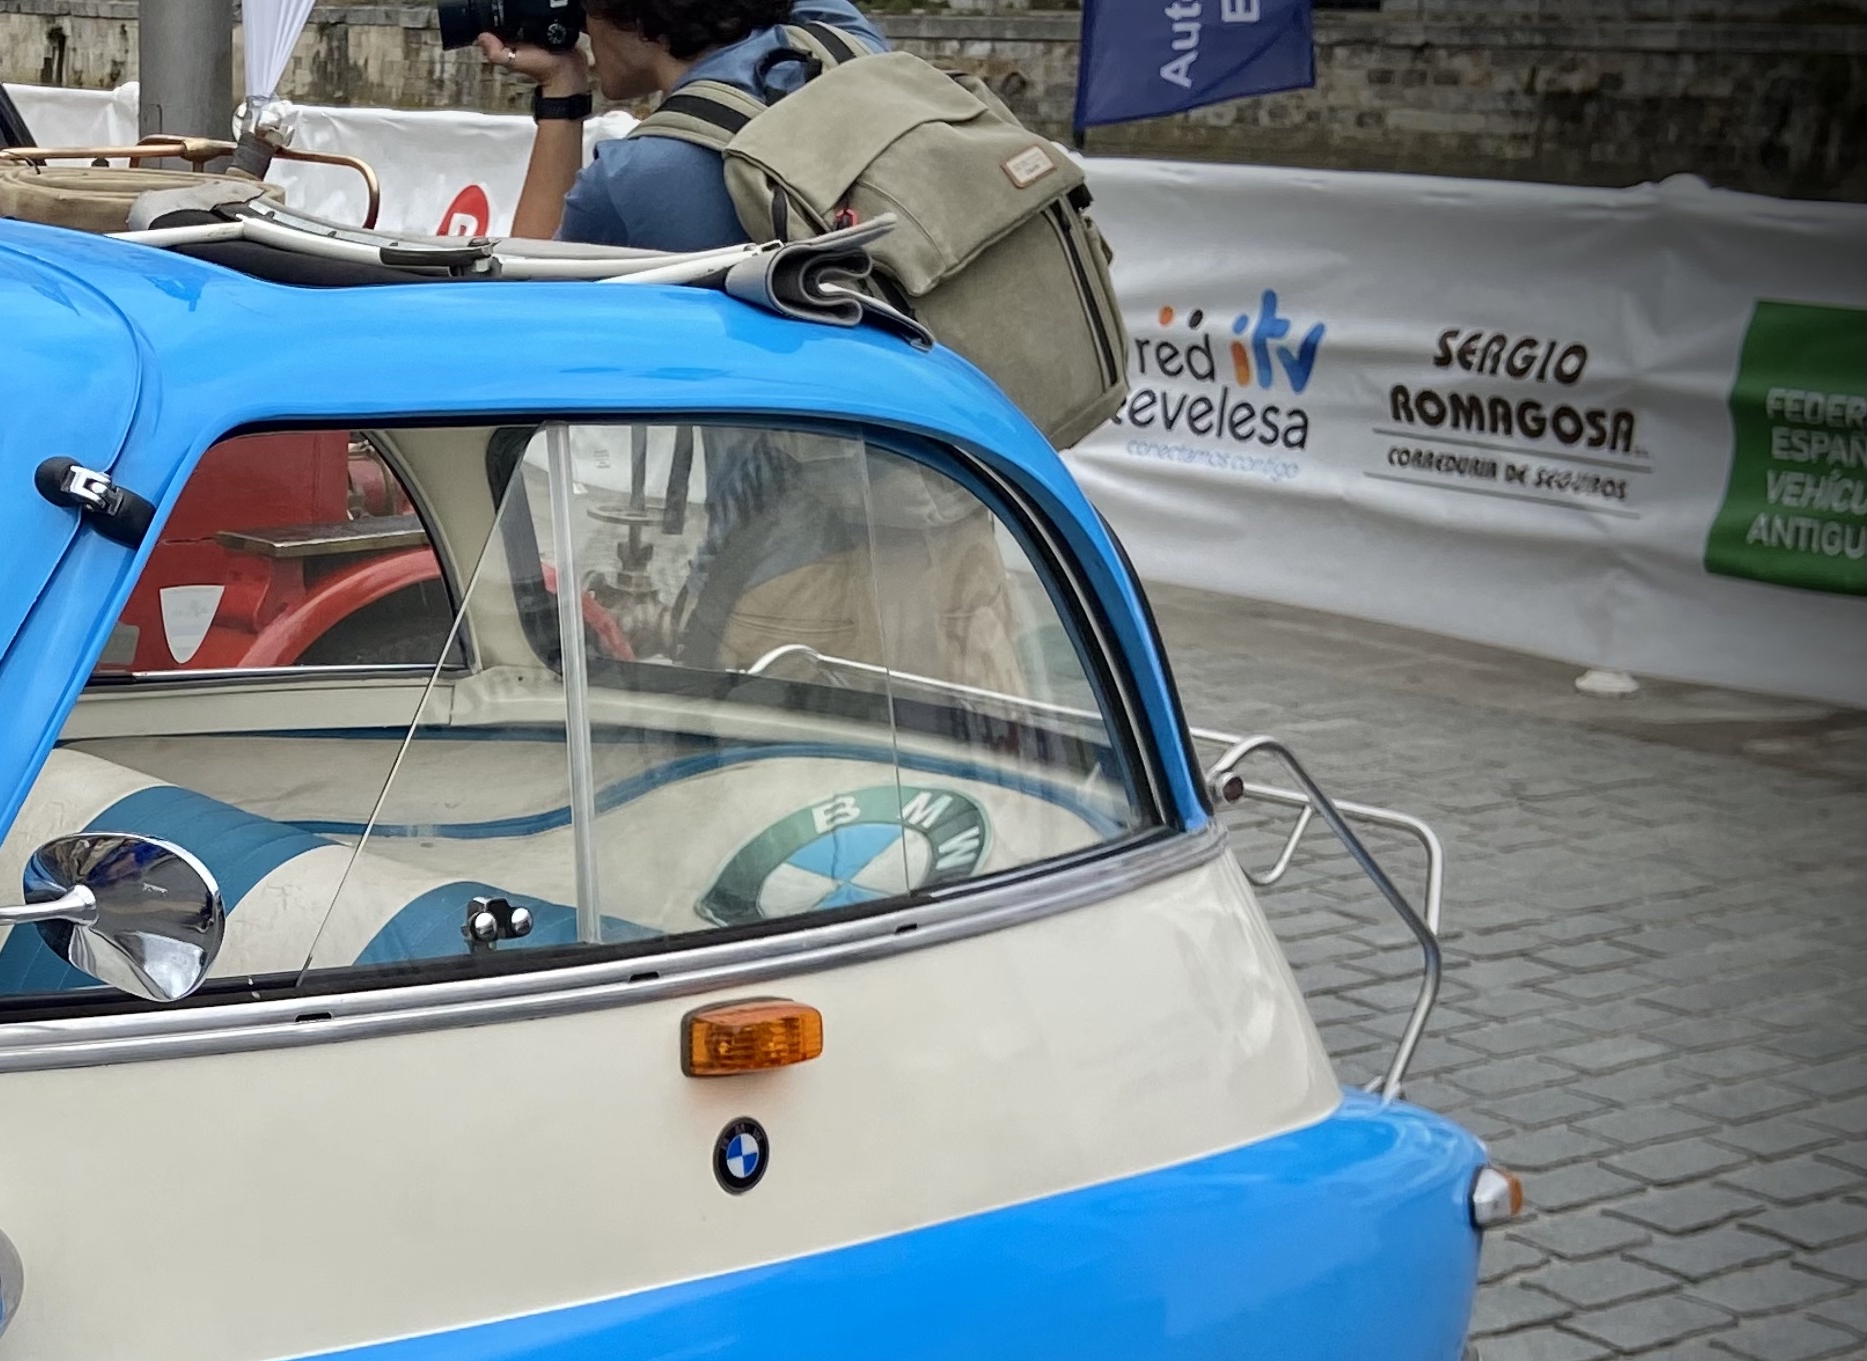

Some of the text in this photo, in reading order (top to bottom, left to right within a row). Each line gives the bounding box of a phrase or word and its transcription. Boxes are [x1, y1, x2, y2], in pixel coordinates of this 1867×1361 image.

[1135, 288, 1325, 395] red itv
[1434, 329, 1588, 385] SERGIO
[1111, 385, 1309, 450] evelesa
[1390, 384, 1636, 454] ROMAGOSA
[1766, 387, 1867, 429] FEDER
[1746, 512, 1867, 560] ANTIGU
